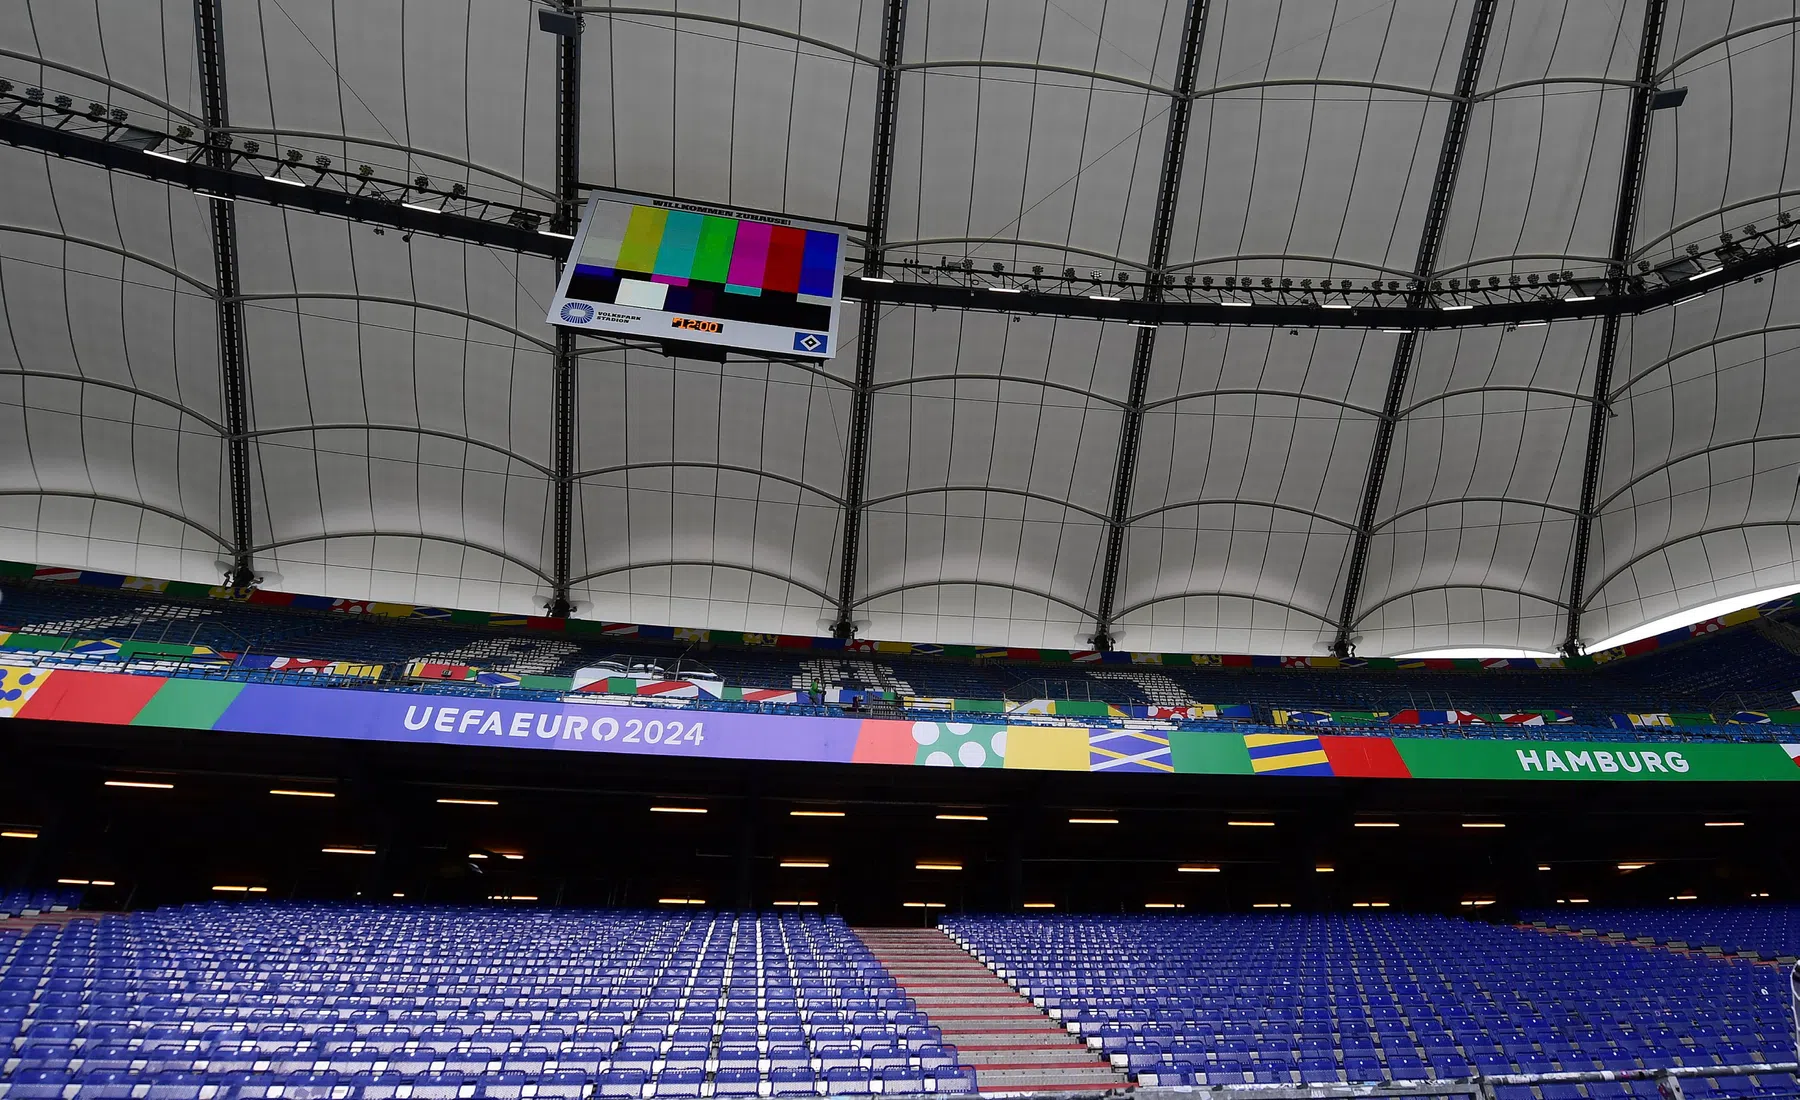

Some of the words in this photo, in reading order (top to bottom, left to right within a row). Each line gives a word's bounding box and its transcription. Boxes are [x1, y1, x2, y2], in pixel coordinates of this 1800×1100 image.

[652, 199, 734, 217] WILLKOMMEN
[736, 212, 792, 226] ZUHAUSE!
[596, 316, 630, 324] STADION
[597, 311, 642, 321] VOLKSPARK
[1516, 749, 1690, 773] HAMBURG
